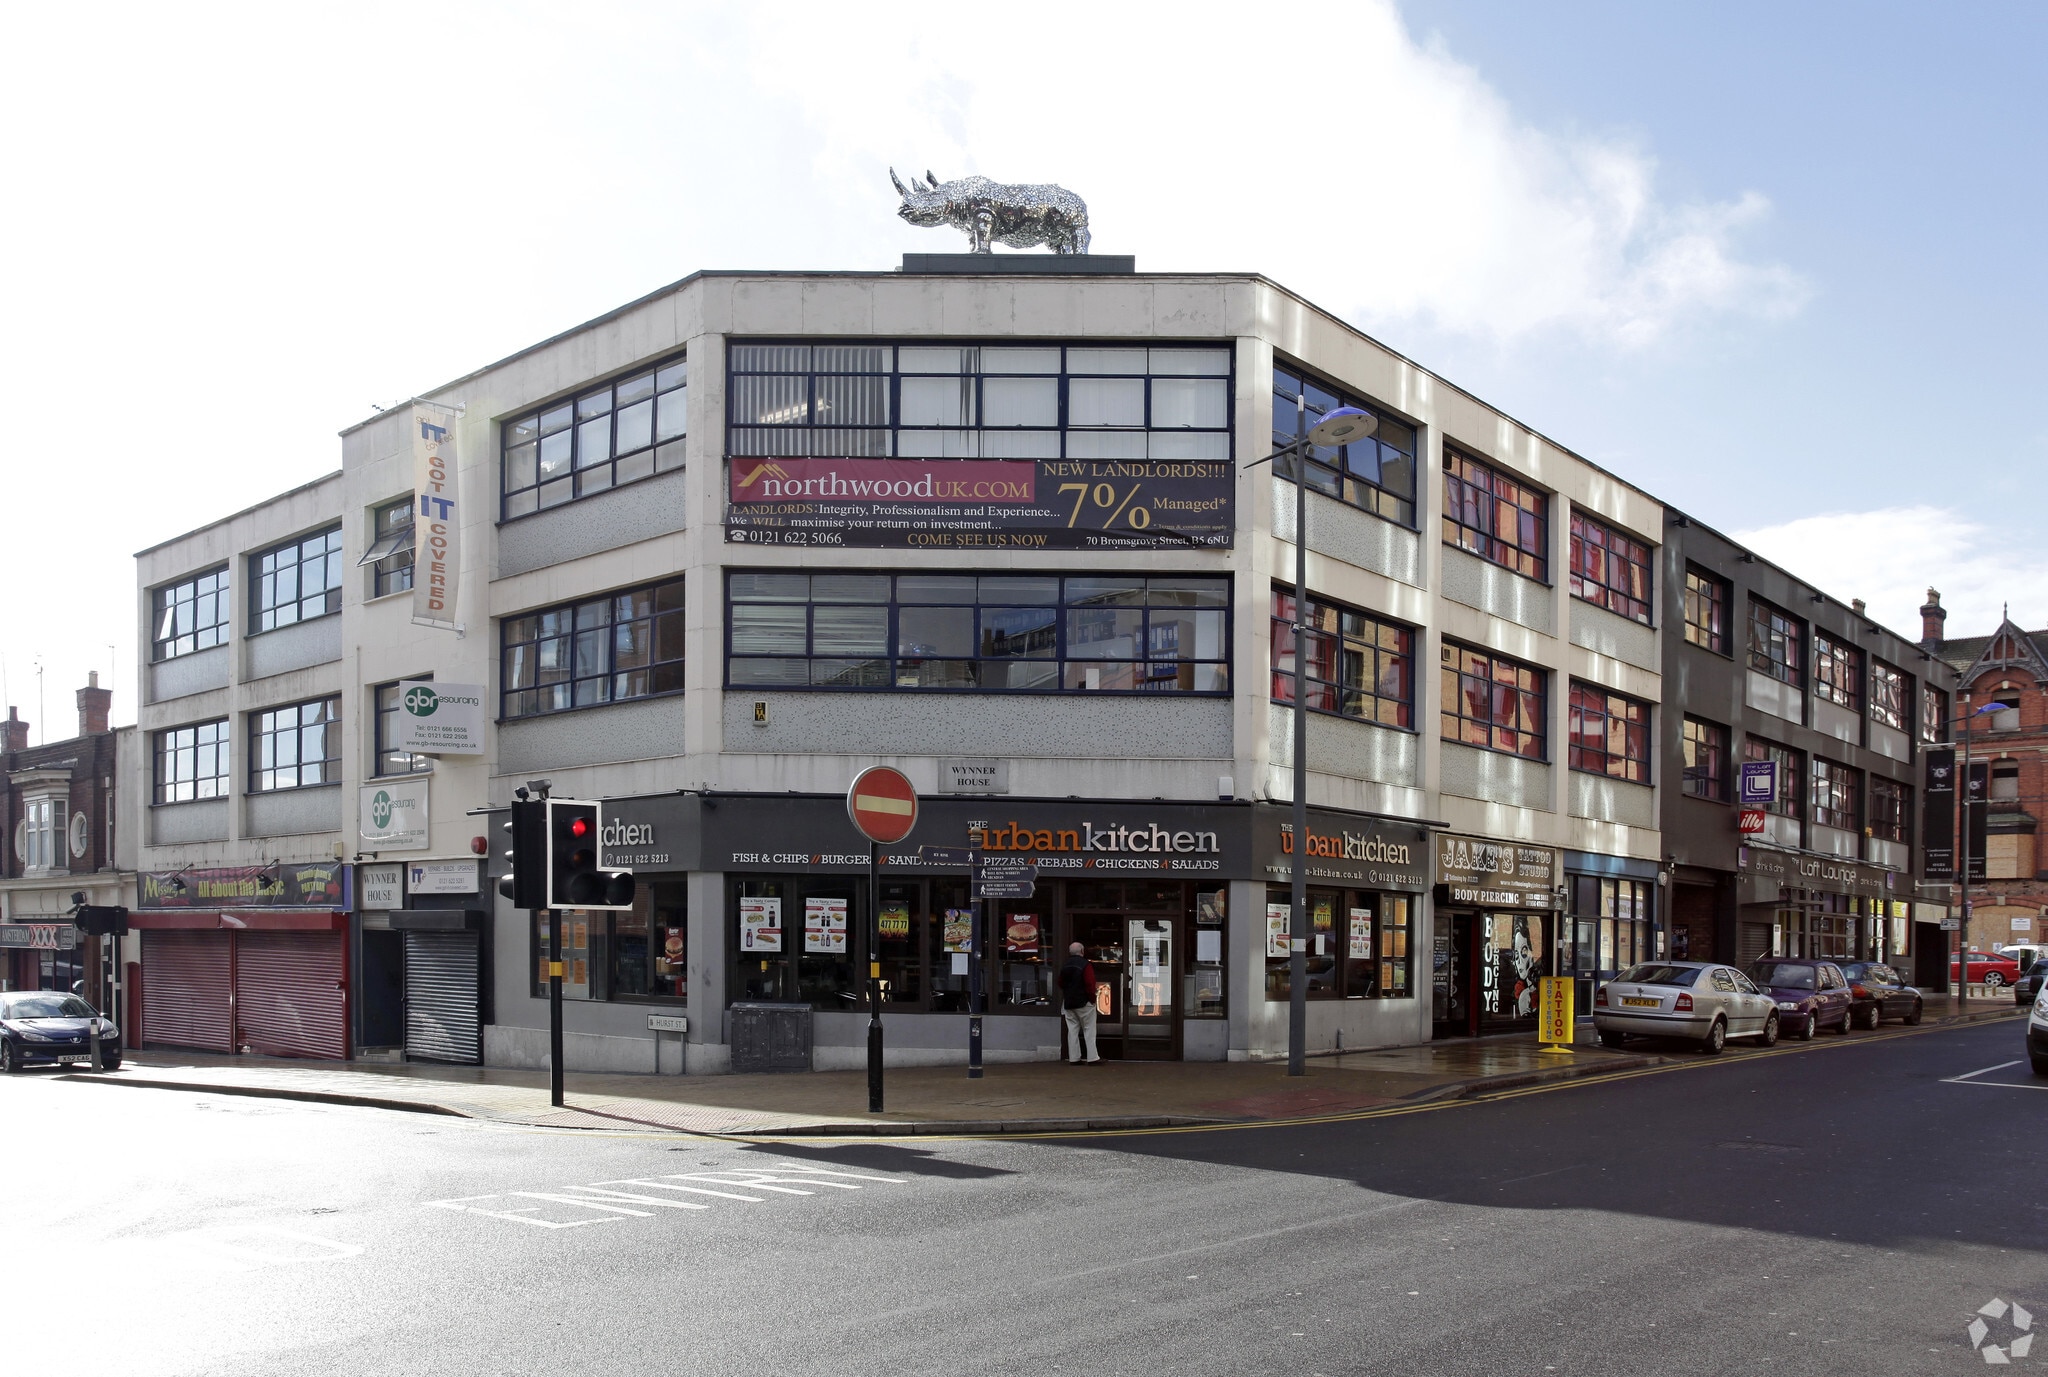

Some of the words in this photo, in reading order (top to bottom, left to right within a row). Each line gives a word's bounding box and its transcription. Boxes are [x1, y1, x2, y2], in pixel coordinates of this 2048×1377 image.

[421, 422, 447, 443] IT
[428, 456, 446, 493] GOT
[1044, 463, 1087, 477] NEW
[1092, 463, 1226, 478] LANDLORDS!!!
[420, 494, 455, 521] IT
[818, 504, 869, 516] Integrity,
[872, 505, 961, 516] Professionalism
[964, 506, 984, 516] and
[987, 506, 1061, 518] Experience...
[1057, 483, 1150, 530] 7%
[729, 517, 747, 525] We
[752, 517, 785, 527] WILL
[790, 518, 845, 527] maximise
[848, 519, 874, 530] your
[876, 519, 910, 529] return
[912, 520, 927, 529] on
[930, 519, 1002, 530] investment...
[750, 531, 780, 543] 0121
[784, 531, 807, 543] 622
[811, 532, 842, 544] 5066
[907, 533, 952, 545] COME
[956, 534, 983, 545] SEE
[987, 534, 1007, 546] US
[1011, 535, 1048, 546] NOW
[1086, 537, 1098, 546] 70
[1100, 536, 1157, 547] Bromsgrove
[1191, 535, 1205, 545] B5
[1207, 535, 1229, 545] 6NU
[428, 523, 448, 611] COVERED
[952, 766, 996, 775] WYNNER
[957, 778, 991, 786] HOUSE
[1281, 823, 1294, 832] THE
[1740, 813, 1764, 831] illy
[616, 855, 632, 864] 0121
[635, 854, 649, 863] 622
[651, 854, 669, 863] 5213
[732, 853, 759, 863] FISH
[761, 854, 771, 863] &
[773, 854, 809, 864] CHIPS
[821, 854, 871, 865] BURGER
[983, 857, 1025, 866] PIZZAS
[1037, 857, 1083, 868] KEBABS
[1095, 858, 1160, 869] CHICKENS
[1172, 859, 1219, 870] SALADS
[1441, 839, 1514, 874] JAKE'S
[1518, 848, 1552, 865] TATTOO
[363, 873, 397, 885] WYNNER
[1266, 865, 1363, 880] www.un-kitchen.co.uk
[1379, 873, 1393, 882] 0121
[1395, 874, 1406, 883] 622
[1408, 876, 1422, 885] 5213
[1519, 864, 1549, 879] STUDIO
[1800, 859, 1820, 877] Loft
[1821, 862, 1857, 885] Lounge
[198, 880, 210, 898] All
[211, 880, 238, 898] about
[239, 879, 254, 897] the
[367, 890, 392, 902] HOUSE
[1454, 888, 1479, 901] BODY
[1480, 890, 1519, 905] PIERCING
[2, 929, 30, 943] AMSTERDAM
[30, 925, 57, 948] XXX
[1483, 917, 1493, 1012] BODY
[1492, 918, 1500, 1013] PIERCING
[1554, 980, 1563, 1037] TATTOO
[656, 1019, 674, 1027] HURST
[420, 1162, 908, 1230] ENTRY
